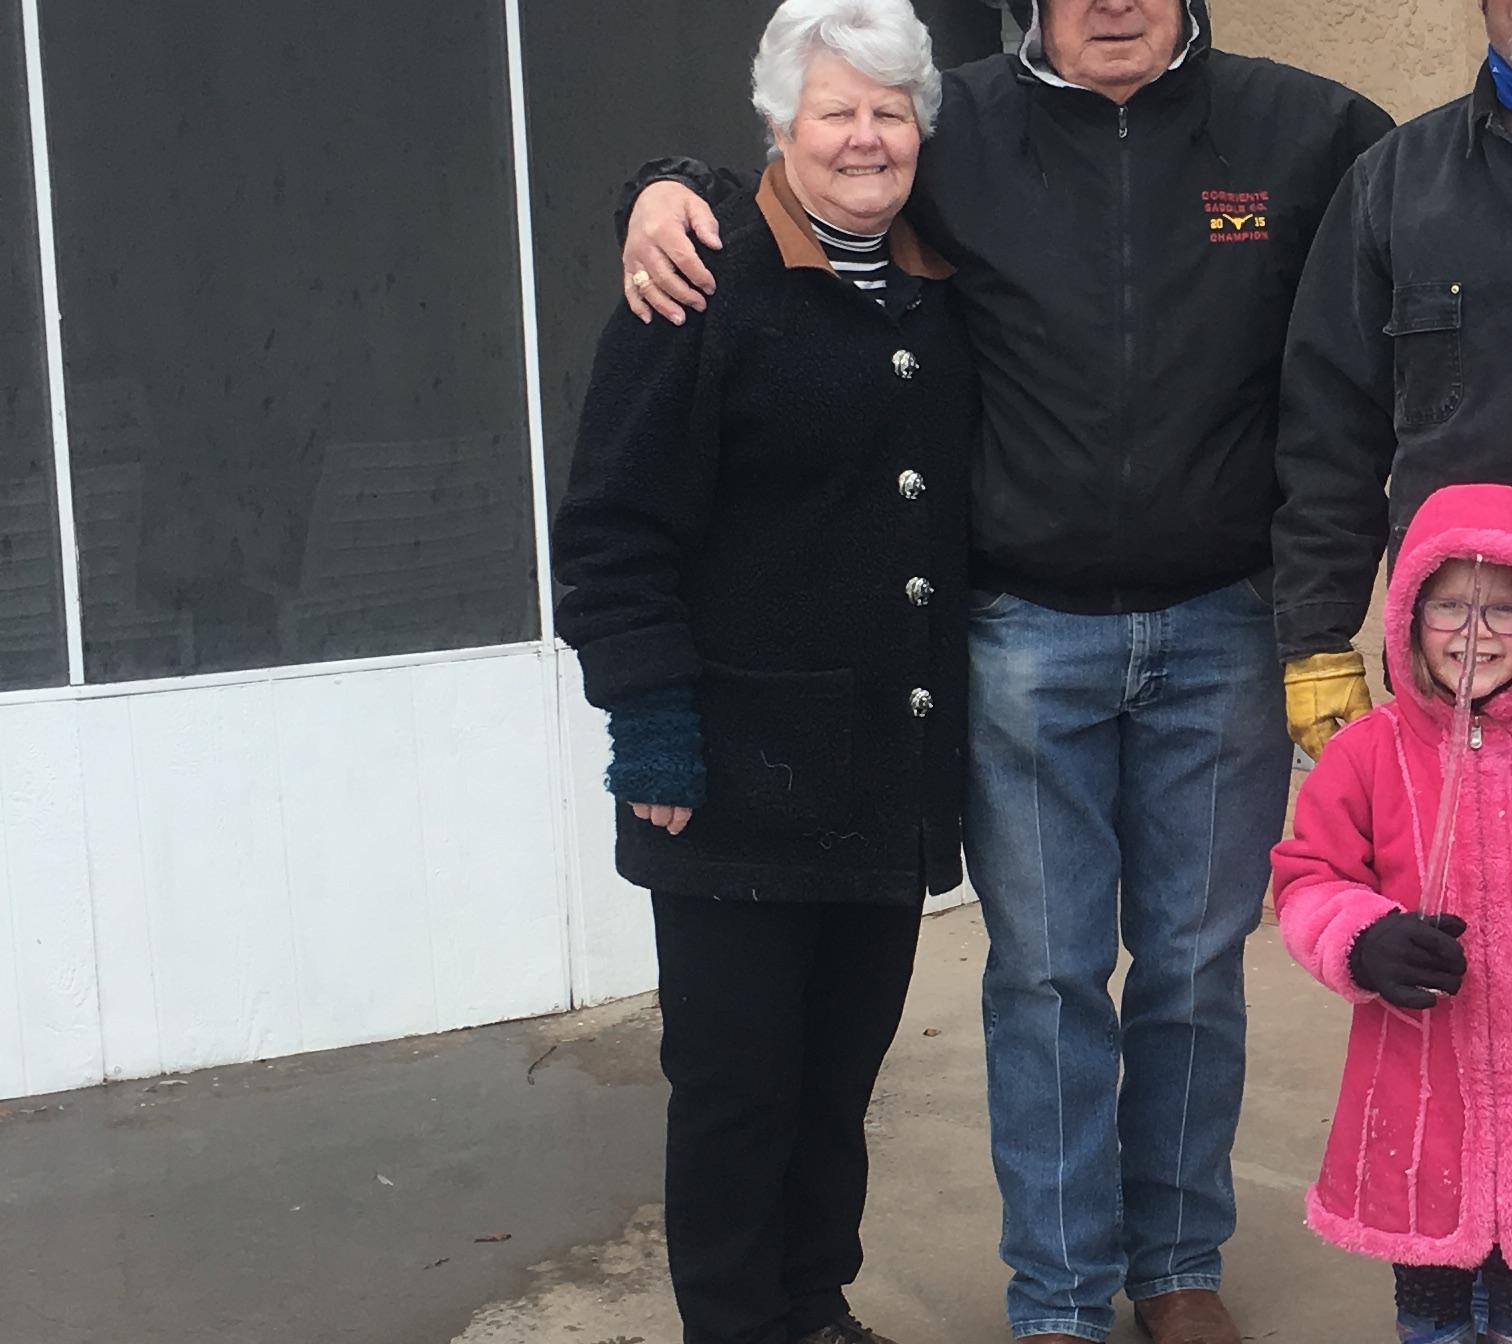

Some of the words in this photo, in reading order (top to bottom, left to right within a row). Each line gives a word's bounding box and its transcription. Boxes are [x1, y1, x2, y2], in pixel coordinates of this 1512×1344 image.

[1201, 190, 1269, 202] CORRIENTE
[1204, 203, 1246, 213] SADDLE
[1210, 218, 1223, 229] 20
[1254, 217, 1266, 227] 15
[1209, 231, 1269, 242] CHAMPION
